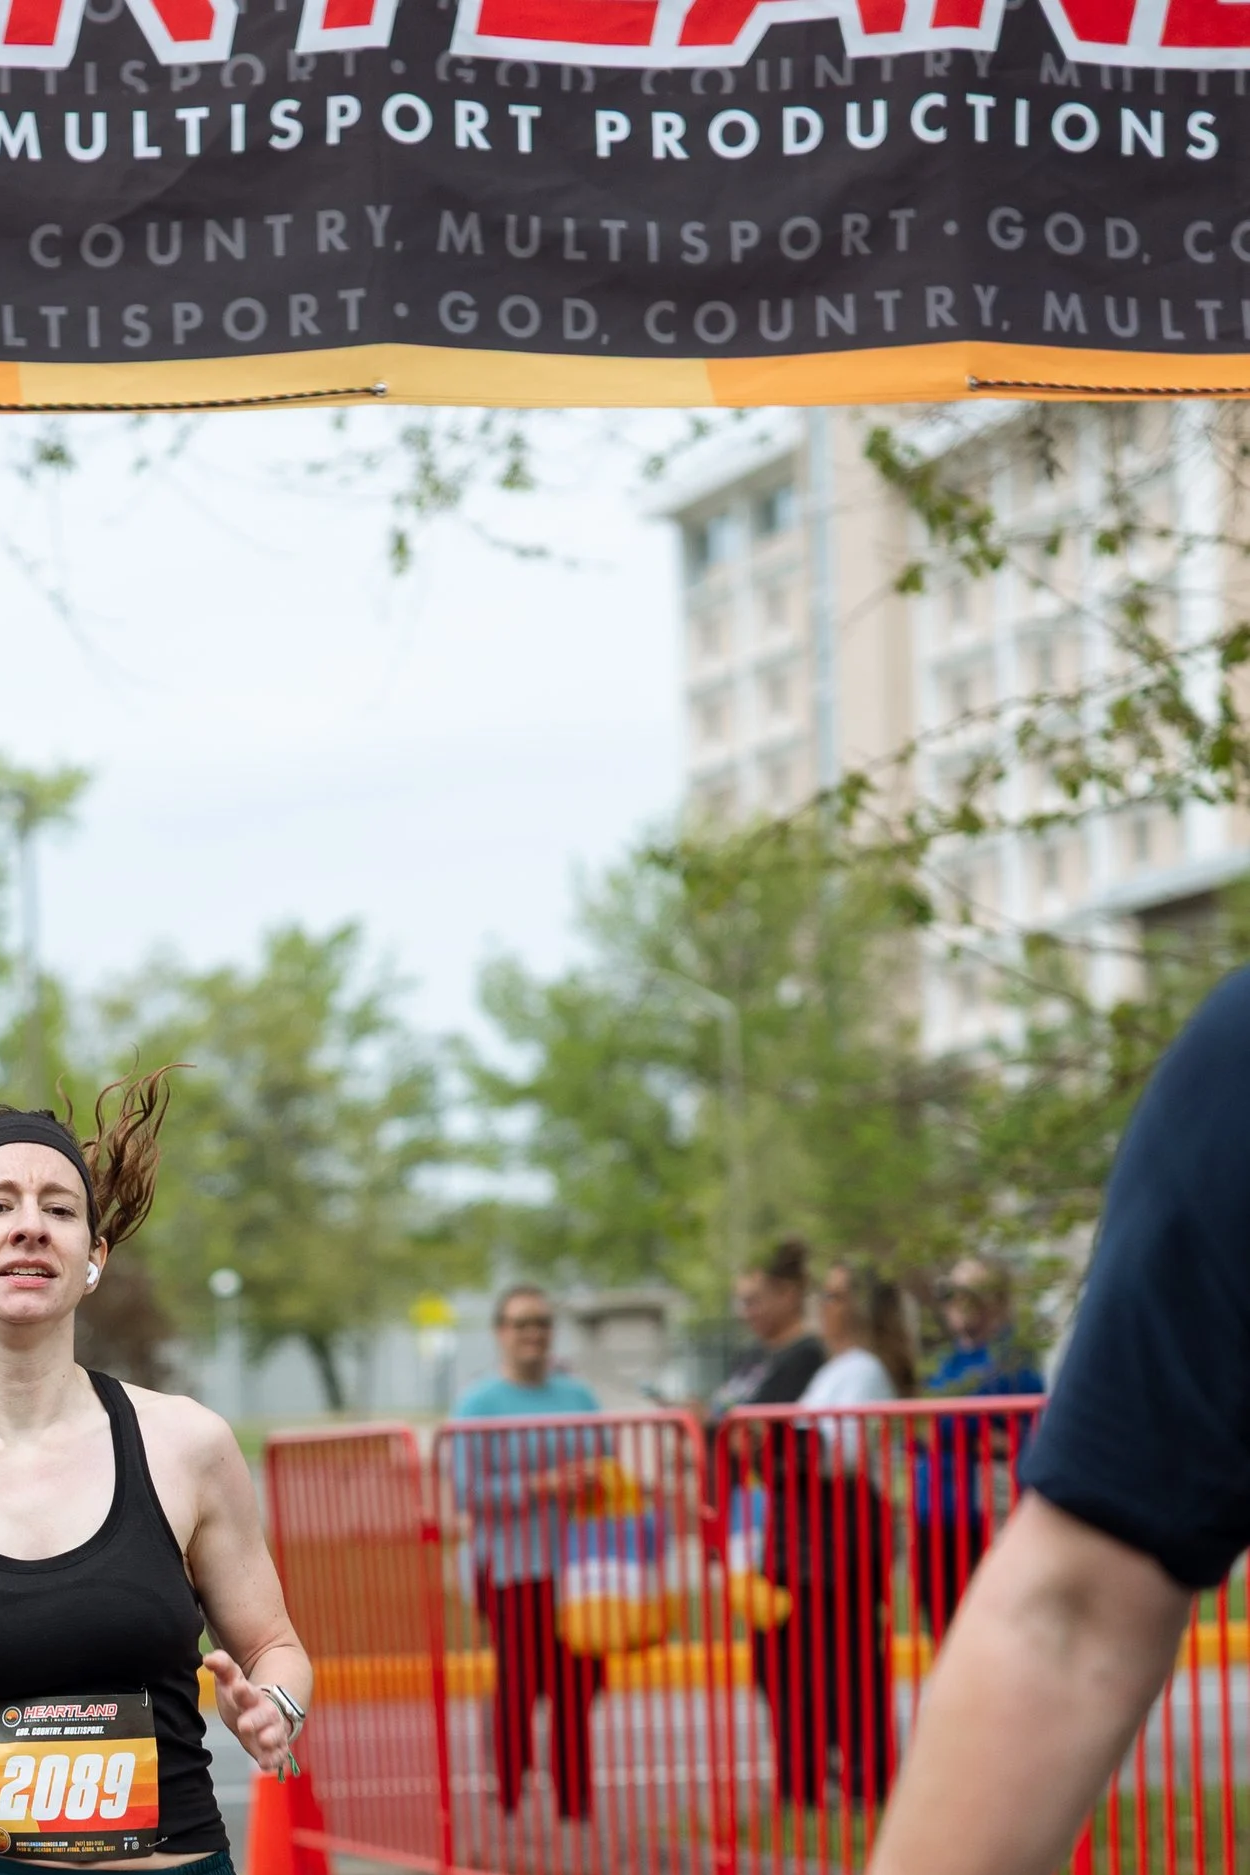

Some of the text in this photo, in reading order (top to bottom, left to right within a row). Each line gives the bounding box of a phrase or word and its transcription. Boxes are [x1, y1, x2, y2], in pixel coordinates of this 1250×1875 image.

[594, 91, 1221, 162] PRODUCTIONS
[29, 204, 403, 269] COUNTRY,
[436, 208, 917, 264] MULTISPORT
[987, 205, 1151, 267] GOD,
[438, 290, 610, 345] GOD,
[643, 283, 1010, 345] COUNTRY,
[23, 1703, 118, 1719] HEARTLAND
